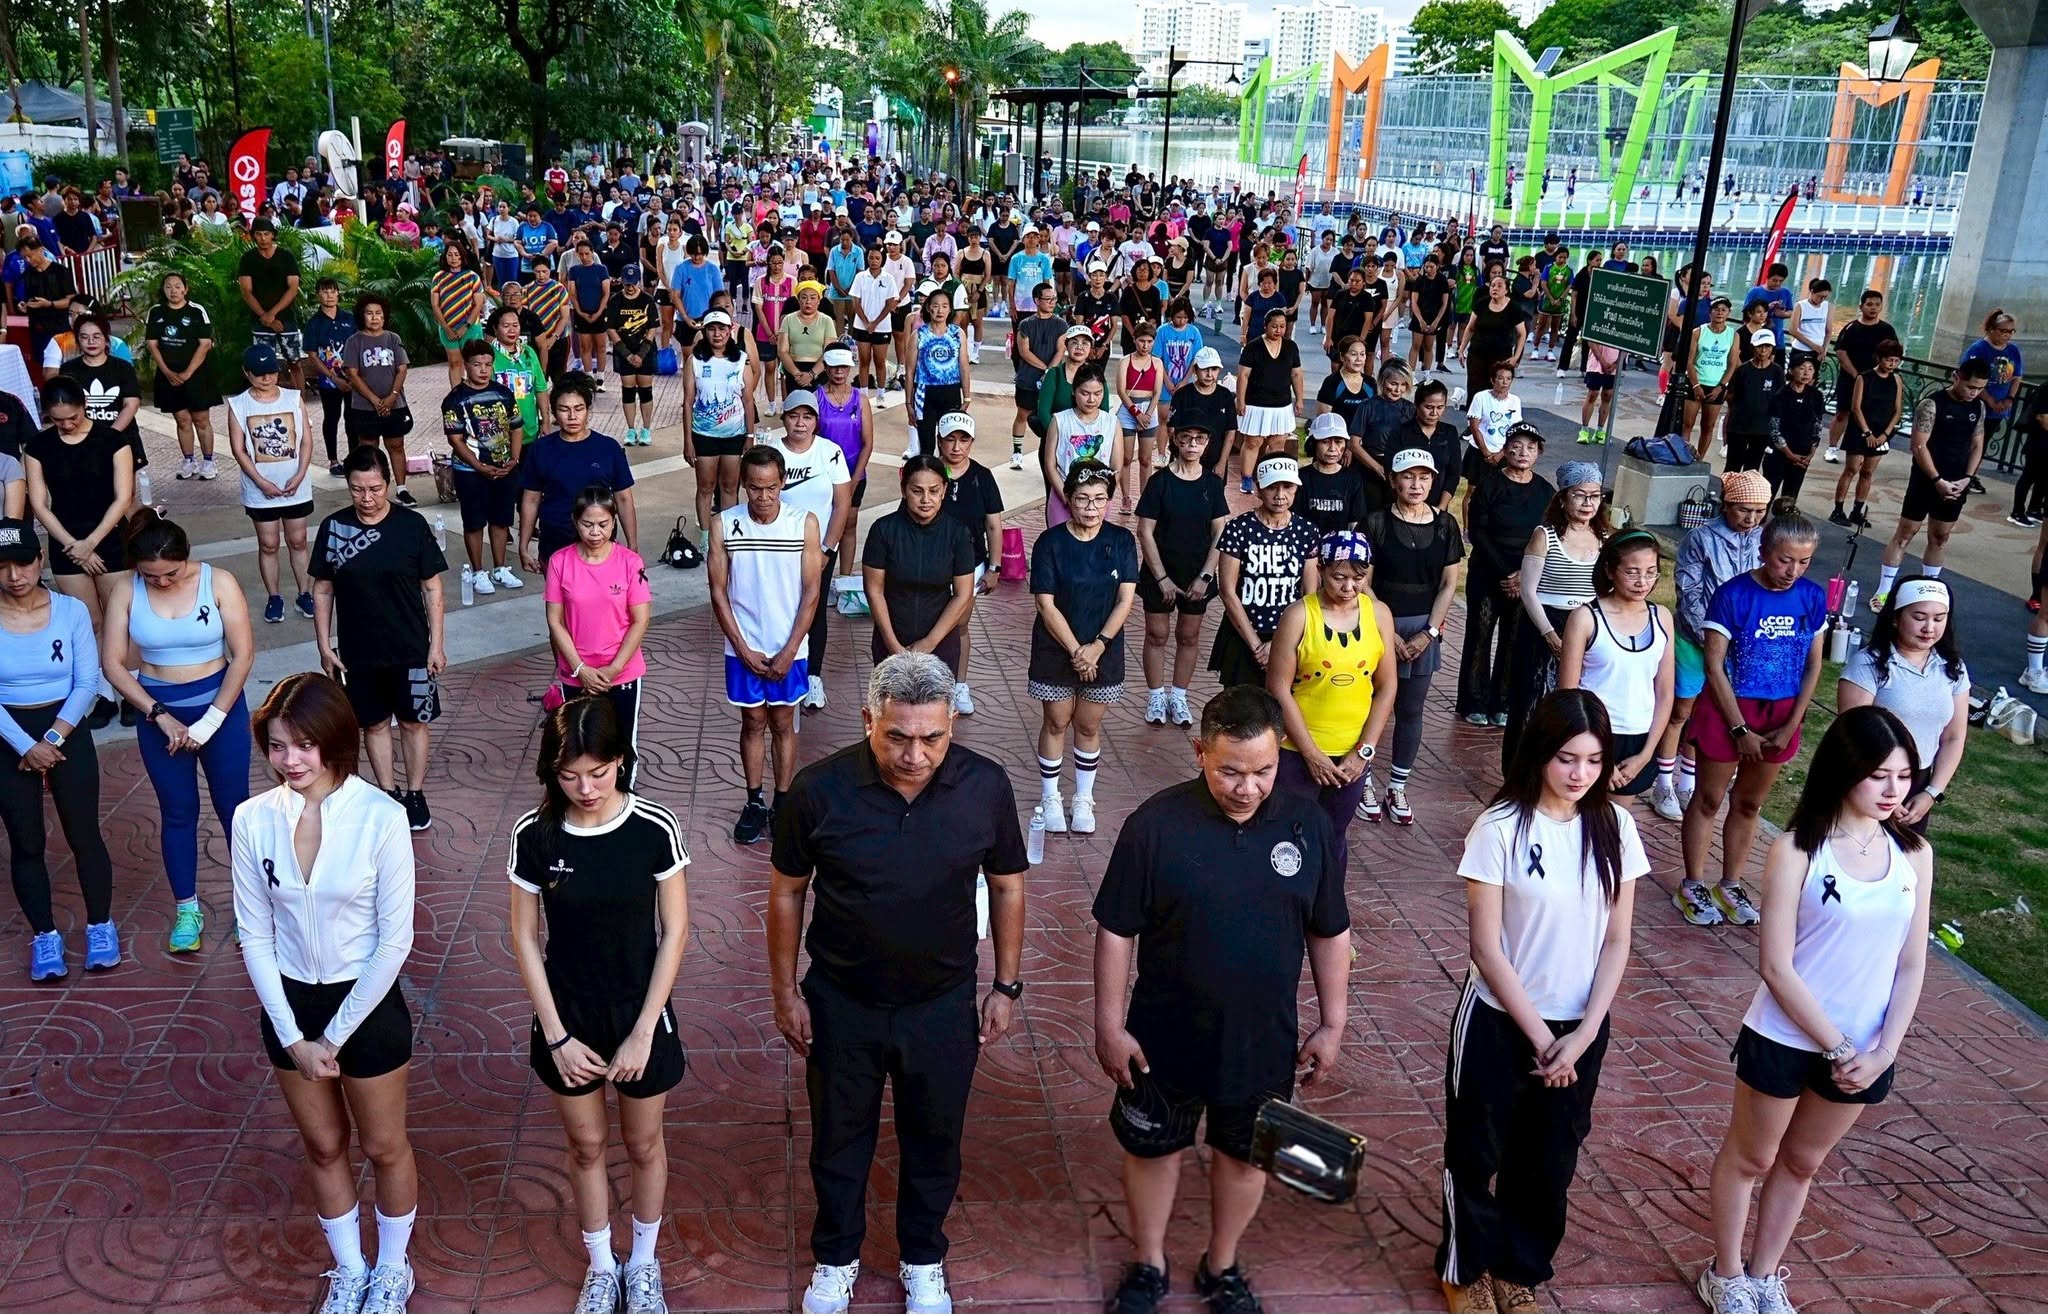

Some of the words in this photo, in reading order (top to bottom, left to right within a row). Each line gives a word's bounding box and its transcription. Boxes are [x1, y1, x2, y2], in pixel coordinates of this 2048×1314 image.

[1700, 359, 1724, 367] adidas
[786, 466, 812, 480] NIKE
[331, 527, 382, 575] didas
[1766, 615, 1795, 626] CGD
